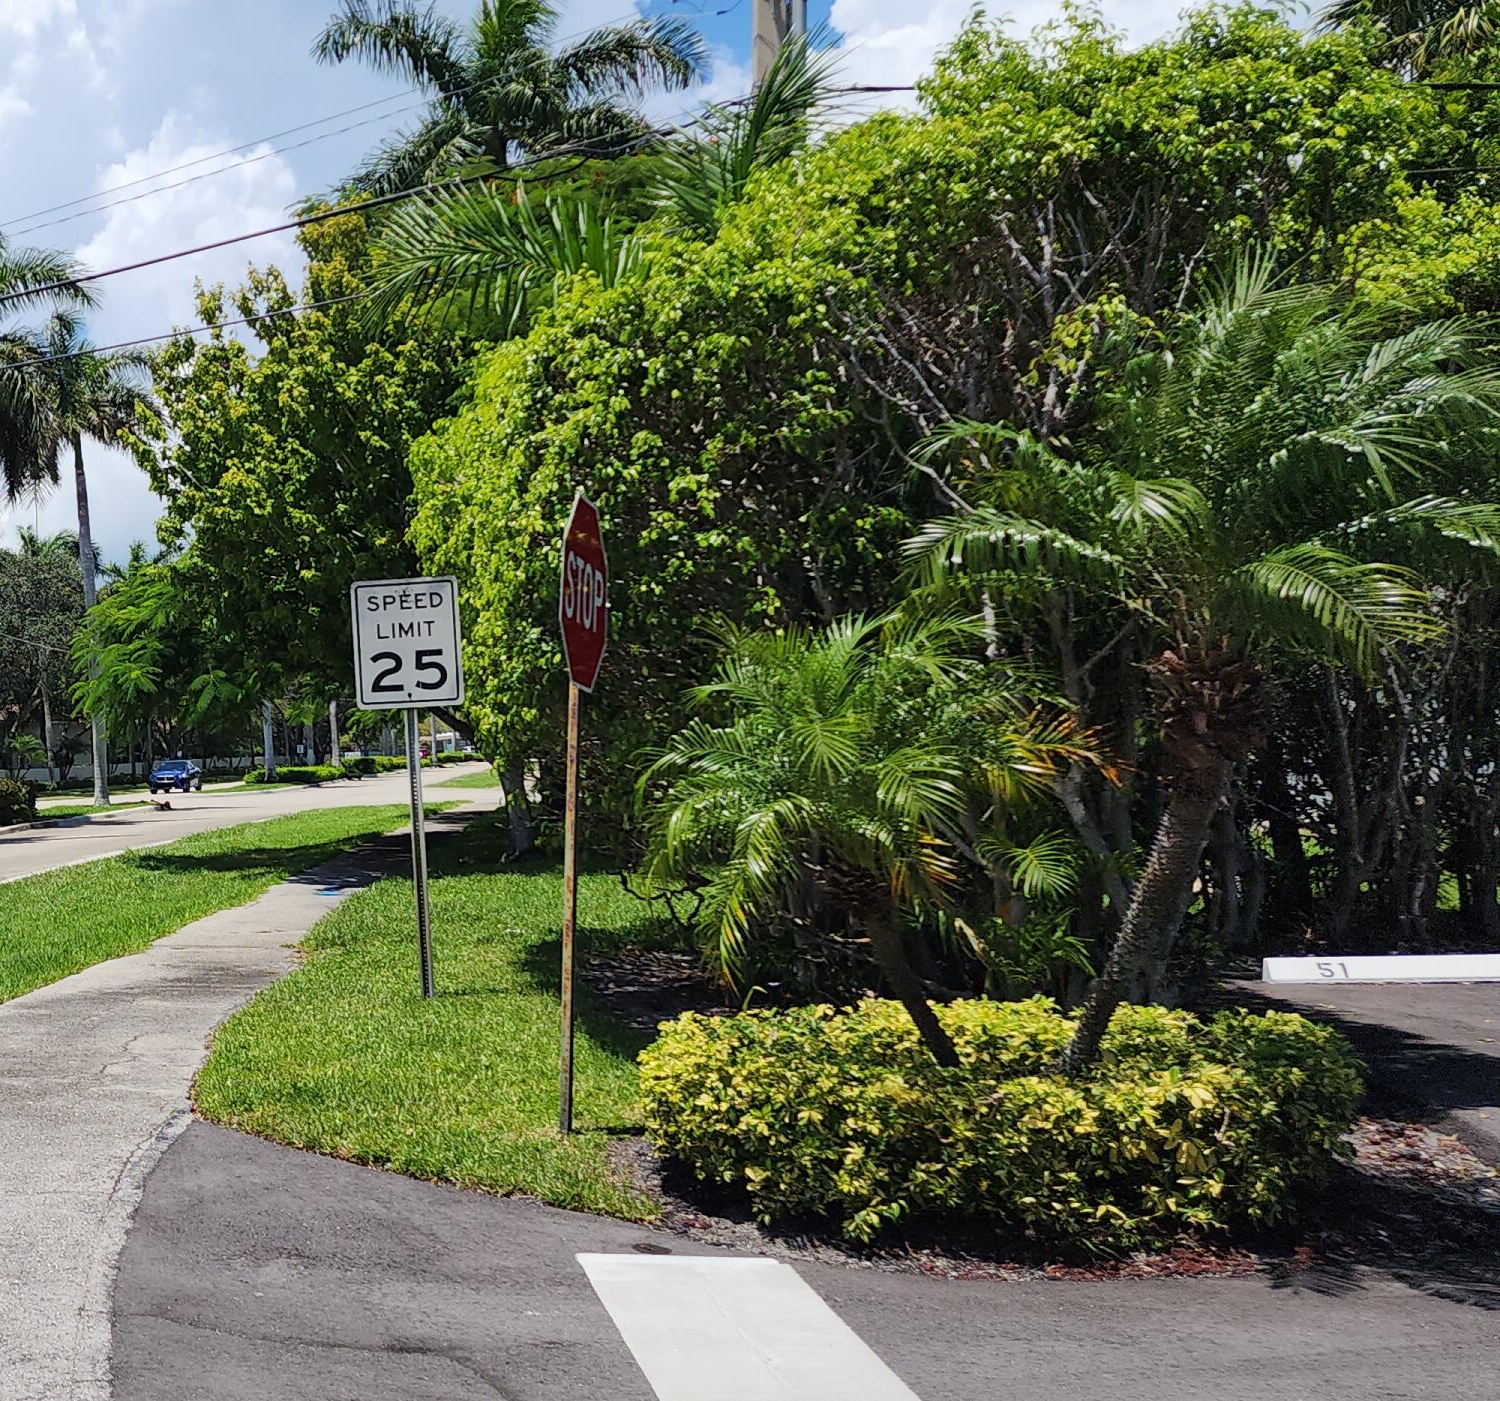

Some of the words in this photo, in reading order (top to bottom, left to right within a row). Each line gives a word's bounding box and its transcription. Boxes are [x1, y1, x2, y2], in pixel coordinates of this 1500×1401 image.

[367, 592, 443, 612] SPEED
[564, 551, 604, 633] STOP
[376, 620, 435, 640] LIMIT
[370, 648, 448, 693] 25
[1316, 962, 1349, 978] 51
